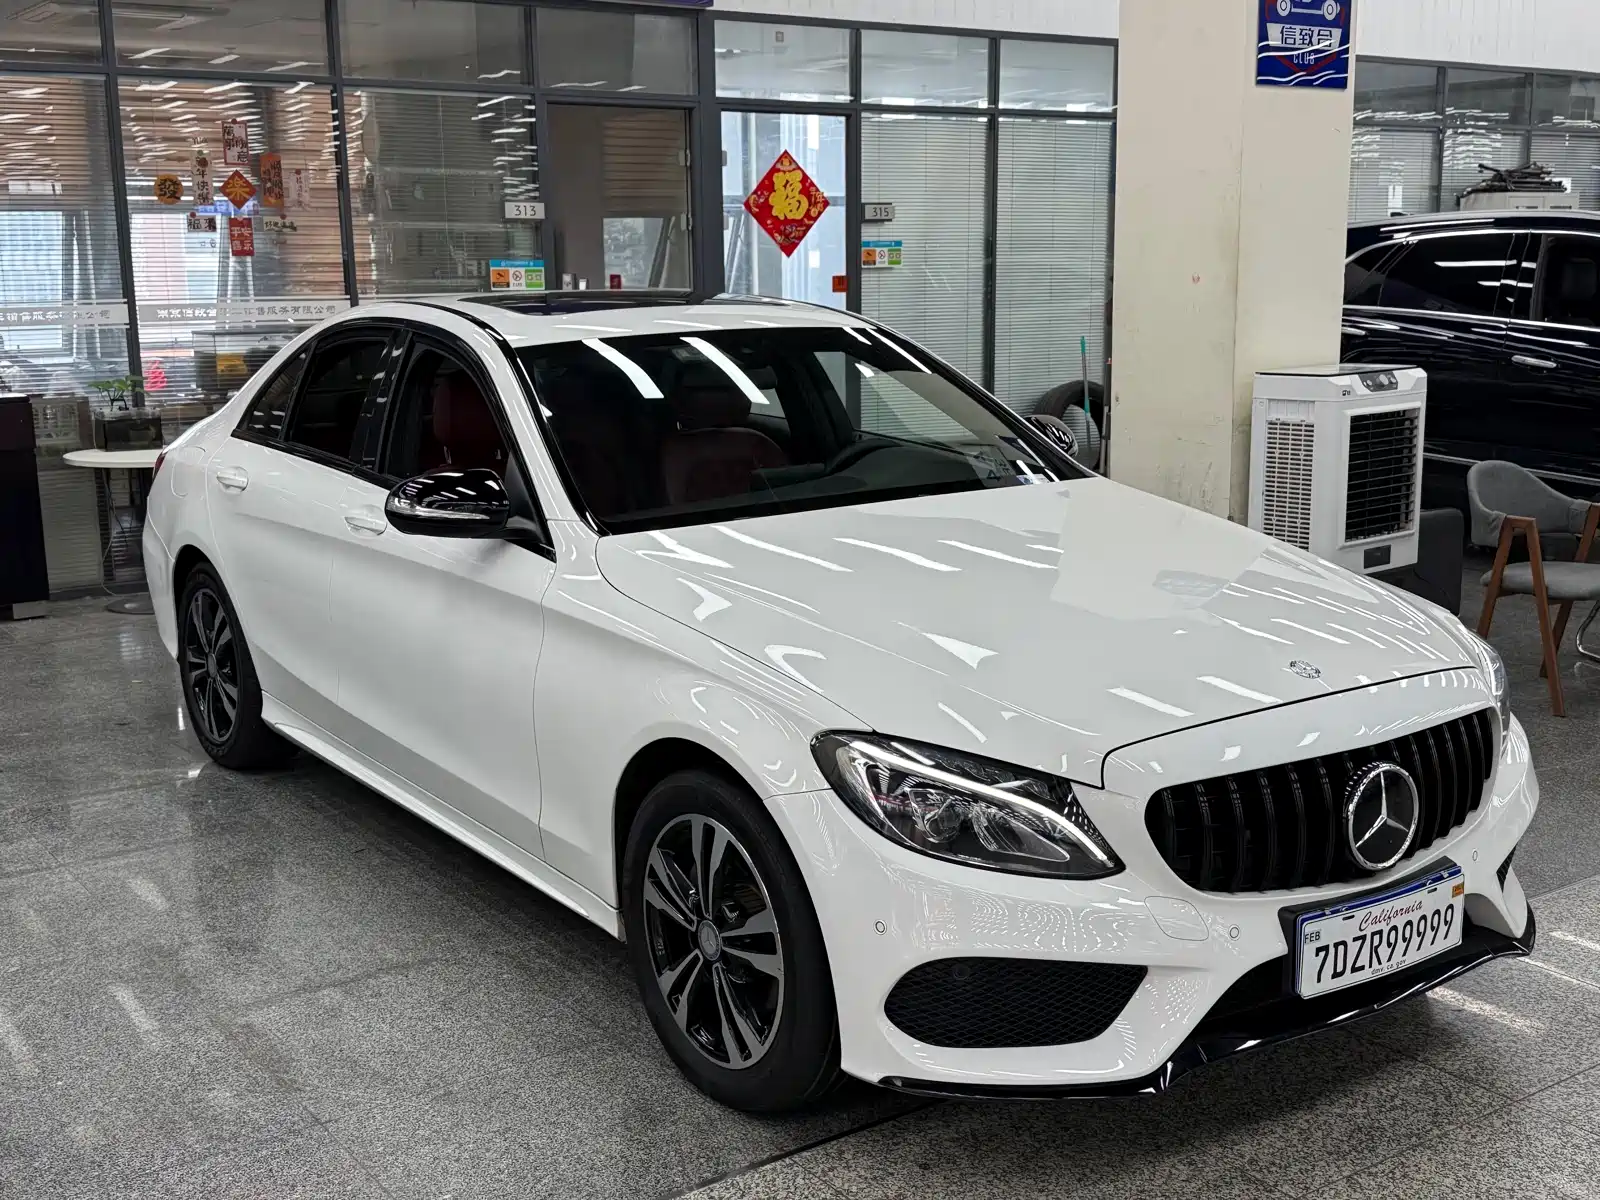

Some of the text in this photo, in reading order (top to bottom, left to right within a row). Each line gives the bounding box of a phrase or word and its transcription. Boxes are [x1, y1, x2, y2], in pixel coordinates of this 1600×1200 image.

[1293, 52, 1315, 64] CLUB
[769, 170, 809, 220] 福
[514, 204, 537, 217] 313
[872, 206, 890, 218] 315
[1358, 900, 1423, 932] California
[1305, 931, 1321, 943] FEB
[1315, 903, 1455, 984] 7DZR99999
